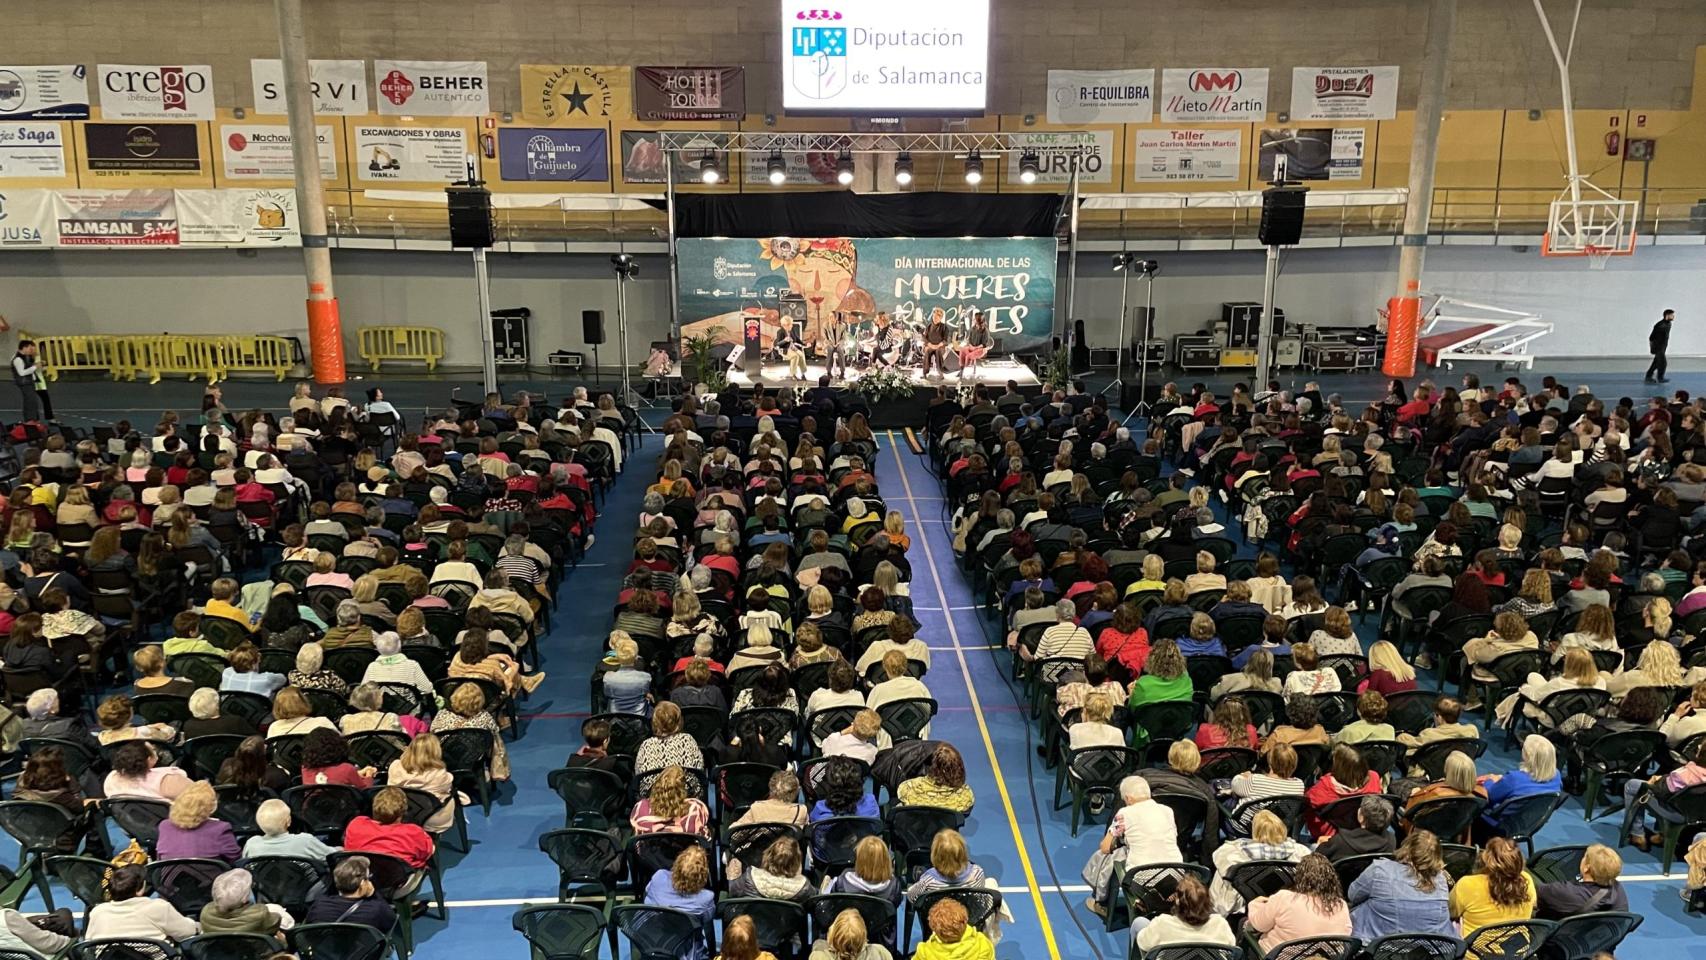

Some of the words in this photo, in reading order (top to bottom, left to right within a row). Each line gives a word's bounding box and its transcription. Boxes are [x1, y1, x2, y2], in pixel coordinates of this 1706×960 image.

[853, 27, 963, 50] Diputación
[667, 76, 713, 89] HOTEL
[852, 71, 870, 84] de
[878, 66, 983, 85] Salamanca
[105, 71, 206, 104] crego
[420, 77, 483, 89] BEHER
[263, 82, 356, 100] SRVI
[543, 67, 569, 118] ESTRELLA
[583, 67, 611, 117] CASTILLA
[1080, 86, 1150, 100] R-EQUILIBRA
[669, 93, 720, 107] TORRES
[18, 127, 56, 143] Saga
[361, 129, 424, 137] EXCAVACIONES
[433, 130, 462, 138] OBRAS
[1171, 131, 1205, 140] Taller
[533, 143, 581, 152] Alhambra
[1085, 146, 1101, 155] DE
[534, 161, 577, 173] Guijuelo
[1038, 155, 1102, 173] URRO
[895, 256, 912, 268] DÍA
[915, 258, 994, 268] INTERNACIONAL
[997, 258, 1010, 268] DE
[1013, 258, 1031, 268] LAS
[895, 272, 1030, 301] MUJERES
